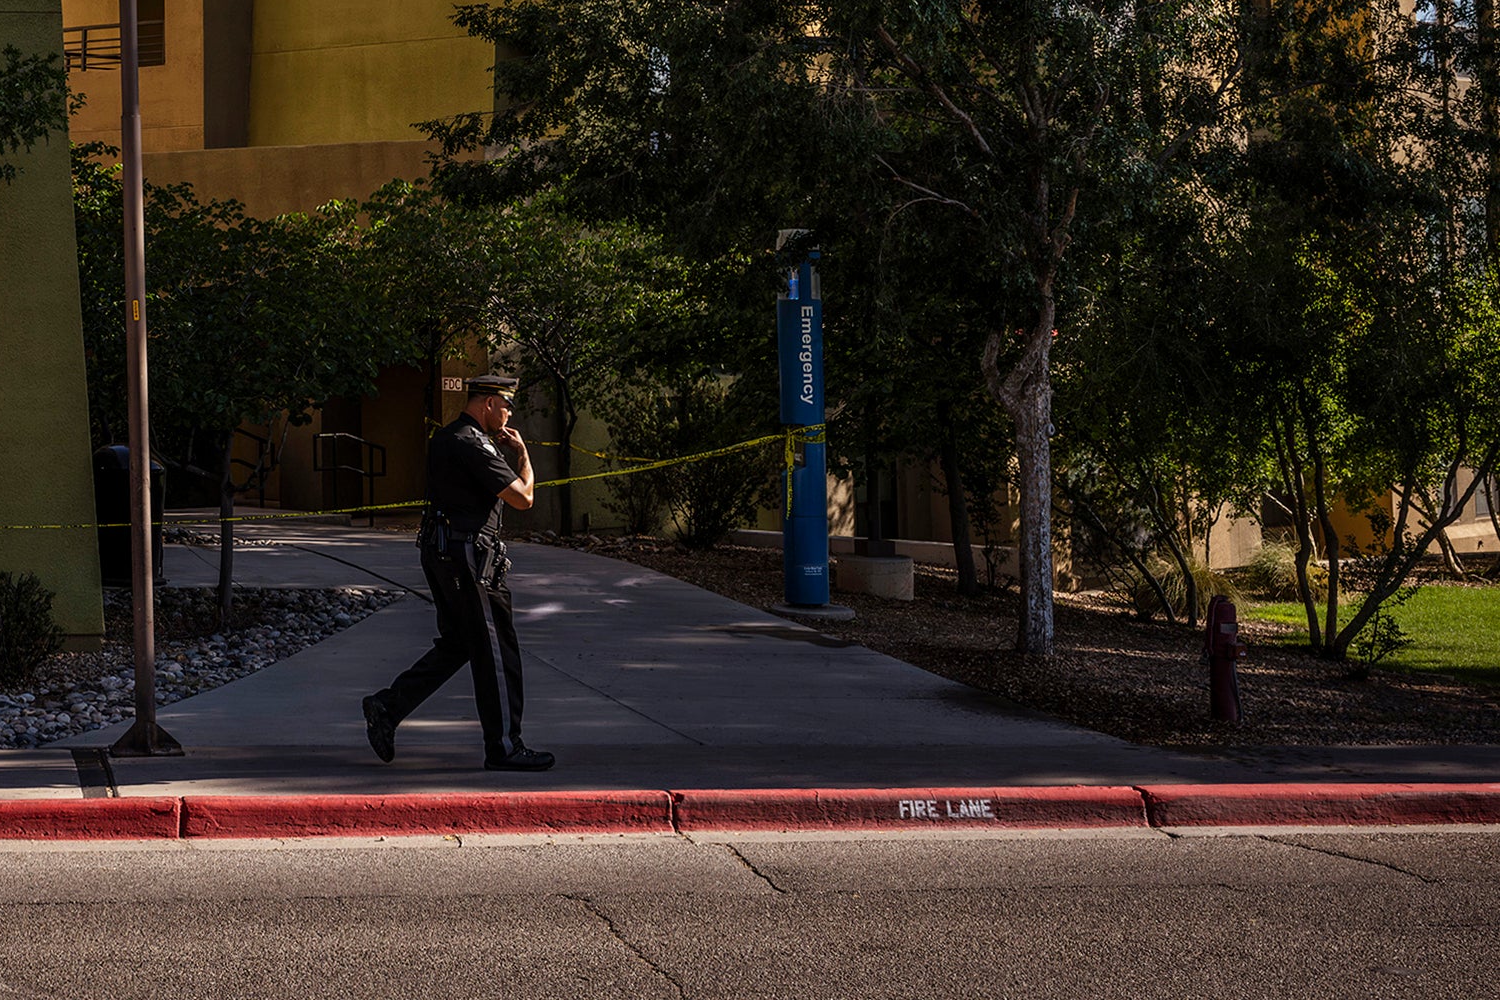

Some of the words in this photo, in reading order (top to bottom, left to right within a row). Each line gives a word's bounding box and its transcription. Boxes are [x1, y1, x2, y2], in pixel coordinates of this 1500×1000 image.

[799, 305, 814, 405] Emergency
[443, 378, 461, 390] FDC
[899, 800, 940, 819] FIRE
[946, 799, 995, 818] LANE
